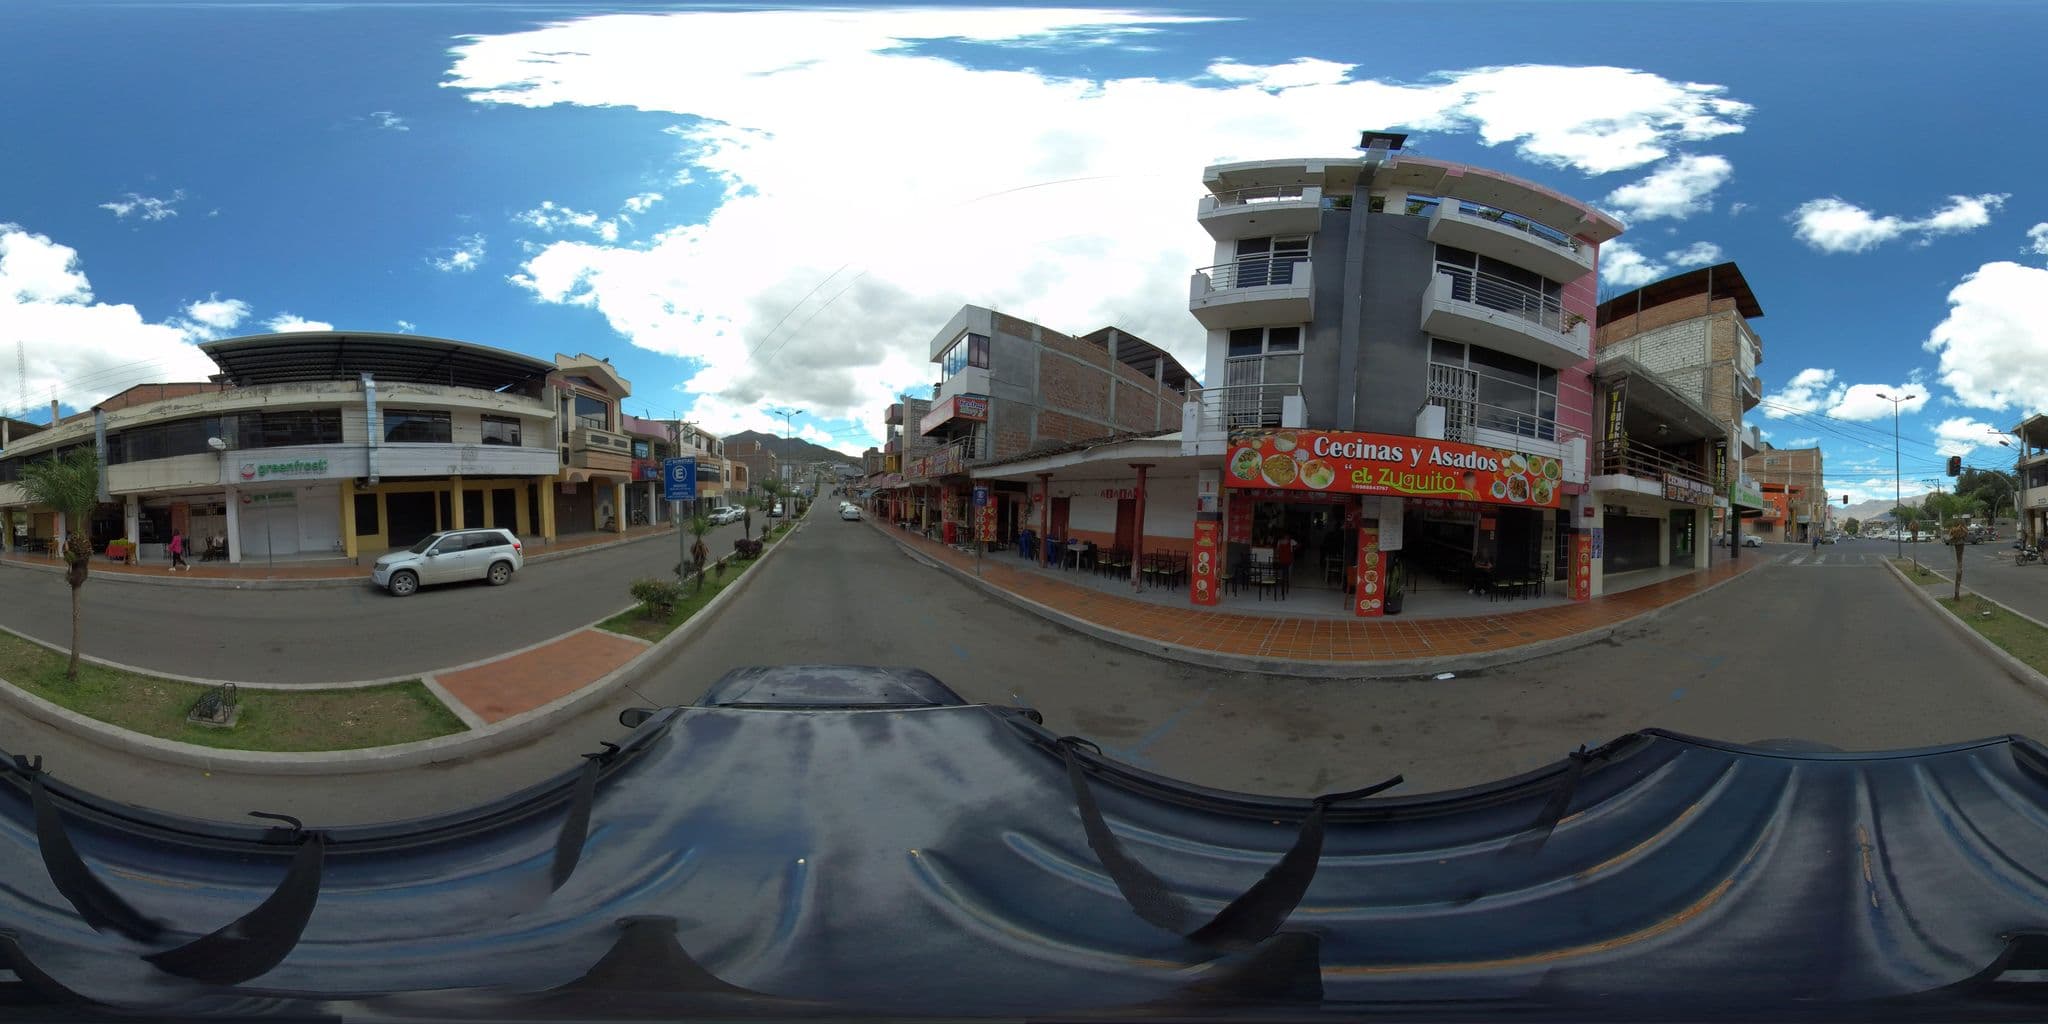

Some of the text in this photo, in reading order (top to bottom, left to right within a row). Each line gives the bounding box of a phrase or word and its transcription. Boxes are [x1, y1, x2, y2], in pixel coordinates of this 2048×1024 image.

[1314, 436, 1498, 472] Cecinas y Asados
[675, 468, 684, 480] E
